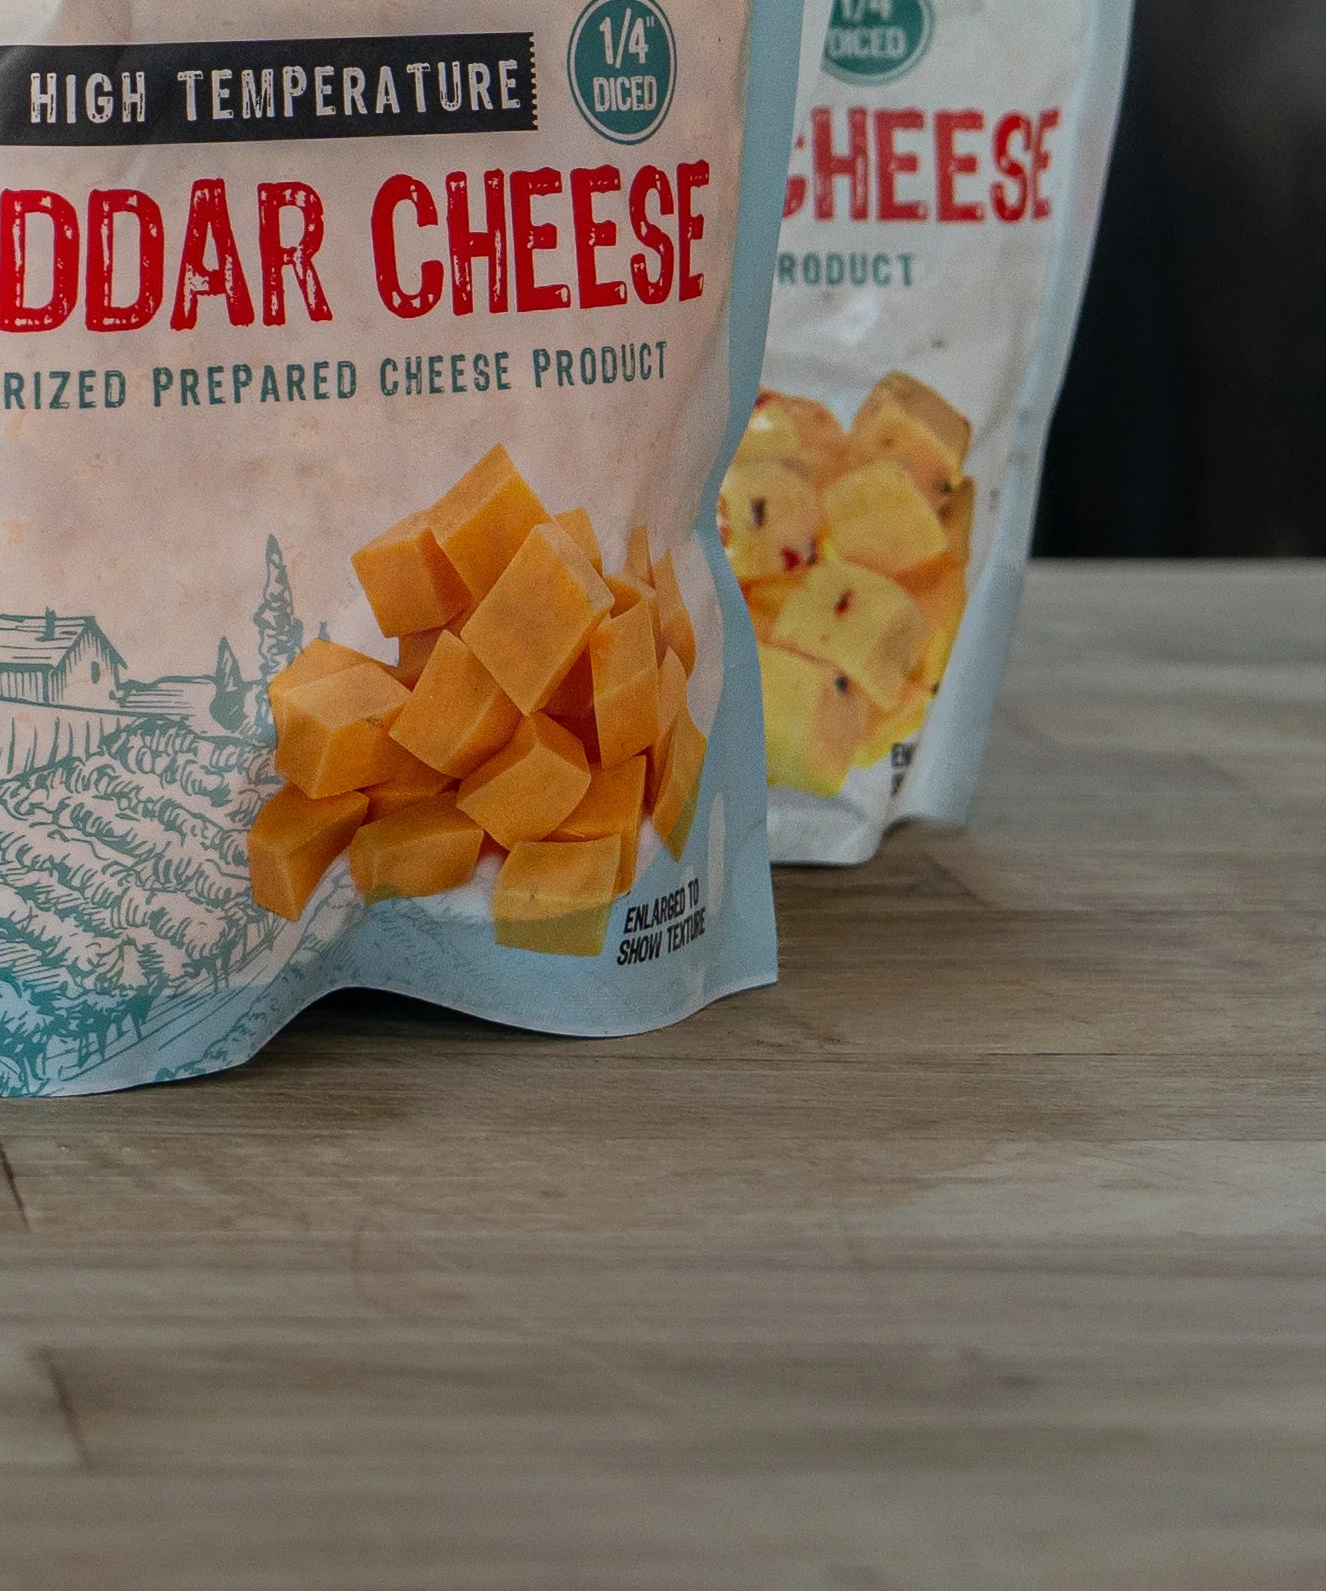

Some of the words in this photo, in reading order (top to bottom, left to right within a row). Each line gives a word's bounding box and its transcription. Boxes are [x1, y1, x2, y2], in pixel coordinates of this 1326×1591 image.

[30, 71, 147, 124] HIGH
[178, 59, 522, 122] TEMPERATURE
[594, 75, 658, 112] DICED
[370, 159, 712, 322] CHEESE
[777, 253, 915, 287] RODUCT
[153, 361, 358, 408] PREPARED
[379, 350, 510, 396] CHEESE
[532, 341, 669, 388] PRODUCT
[624, 887, 685, 934] ENLARGED
[688, 877, 699, 908] TO
[617, 931, 663, 965] SHOW
[667, 907, 705, 953] TEXTURE
